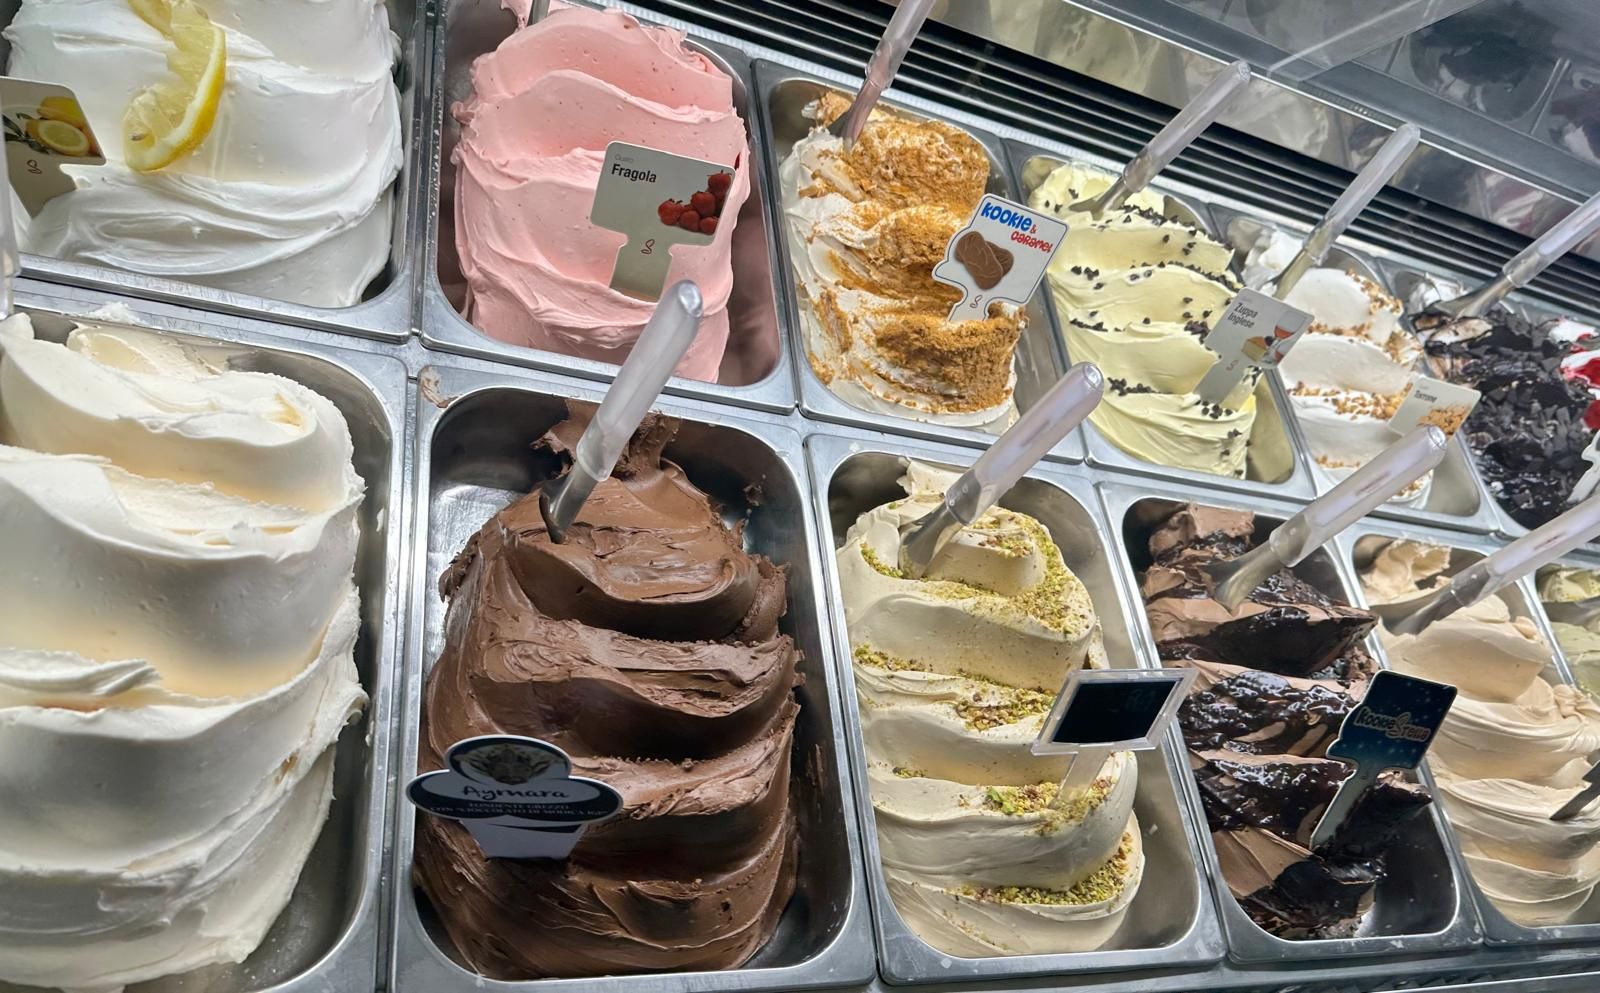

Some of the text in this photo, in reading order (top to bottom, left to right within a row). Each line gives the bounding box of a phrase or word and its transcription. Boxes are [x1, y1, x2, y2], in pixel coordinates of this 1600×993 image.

[611, 163, 657, 183] Fragola
[1030, 224, 1037, 234] &
[1234, 302, 1258, 318] Zuppa
[1227, 312, 1255, 328] Inglese
[461, 784, 570, 800] Aymara
